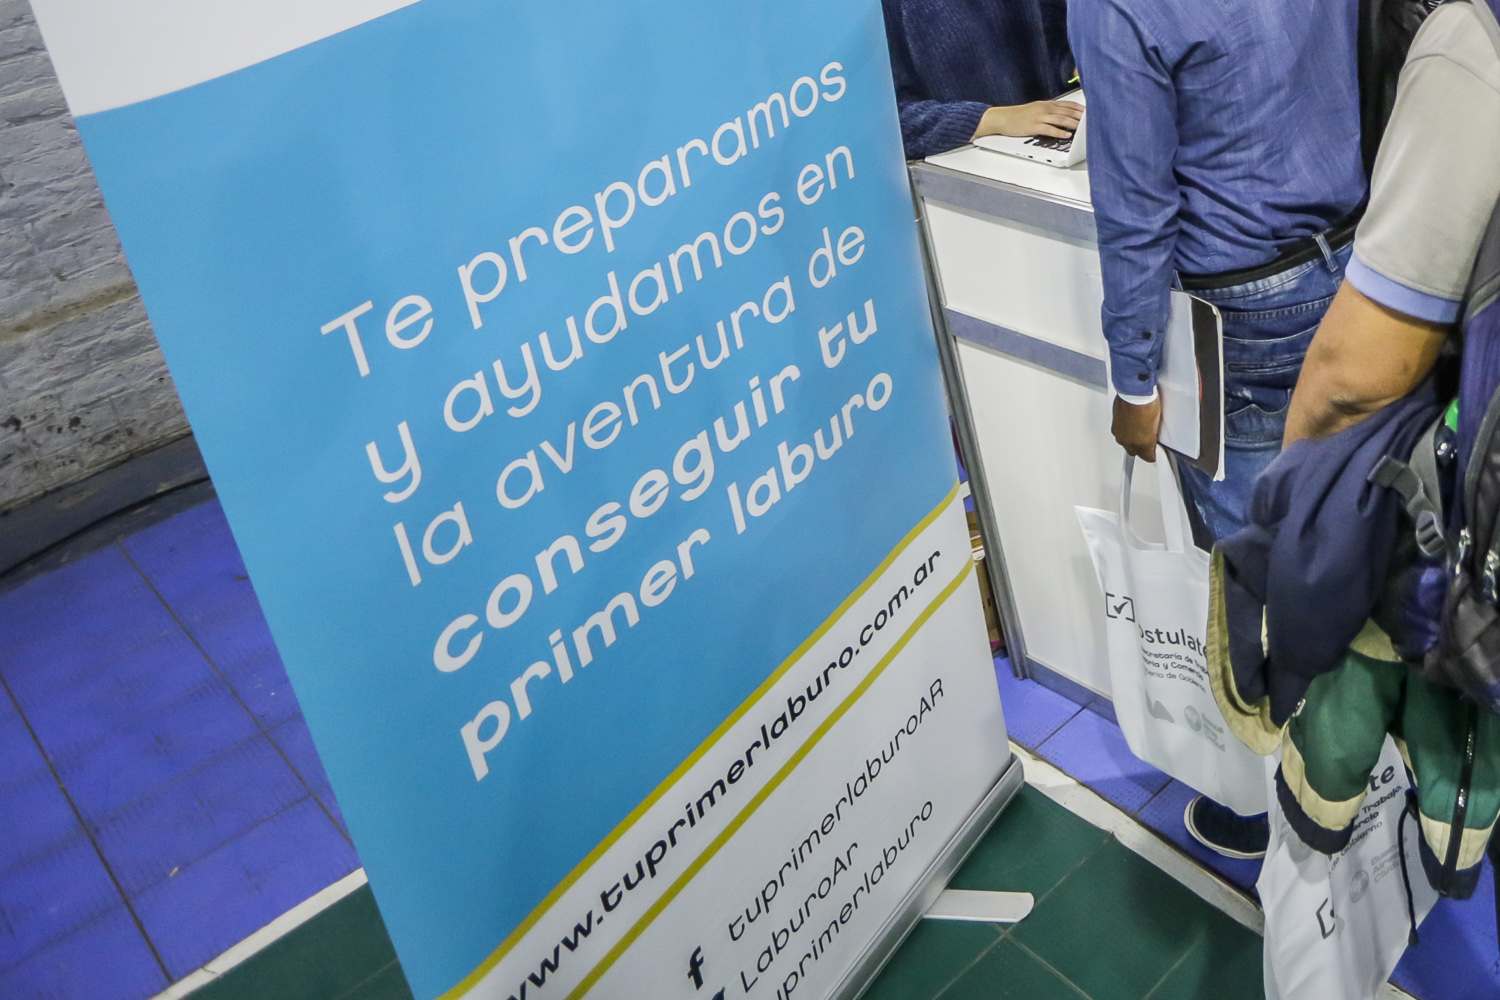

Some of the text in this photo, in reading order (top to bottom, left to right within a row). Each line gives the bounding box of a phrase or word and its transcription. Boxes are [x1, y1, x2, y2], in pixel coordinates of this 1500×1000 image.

[320, 60, 848, 379] Te preparamos
[365, 144, 856, 504] y ayudamos en
[392, 224, 867, 588] la aventura de
[431, 297, 879, 675] conseguir tu
[459, 371, 894, 783] primer laburo
[727, 677, 947, 942] tuprimerlaburoAR
[739, 840, 861, 994] LaburoAr
